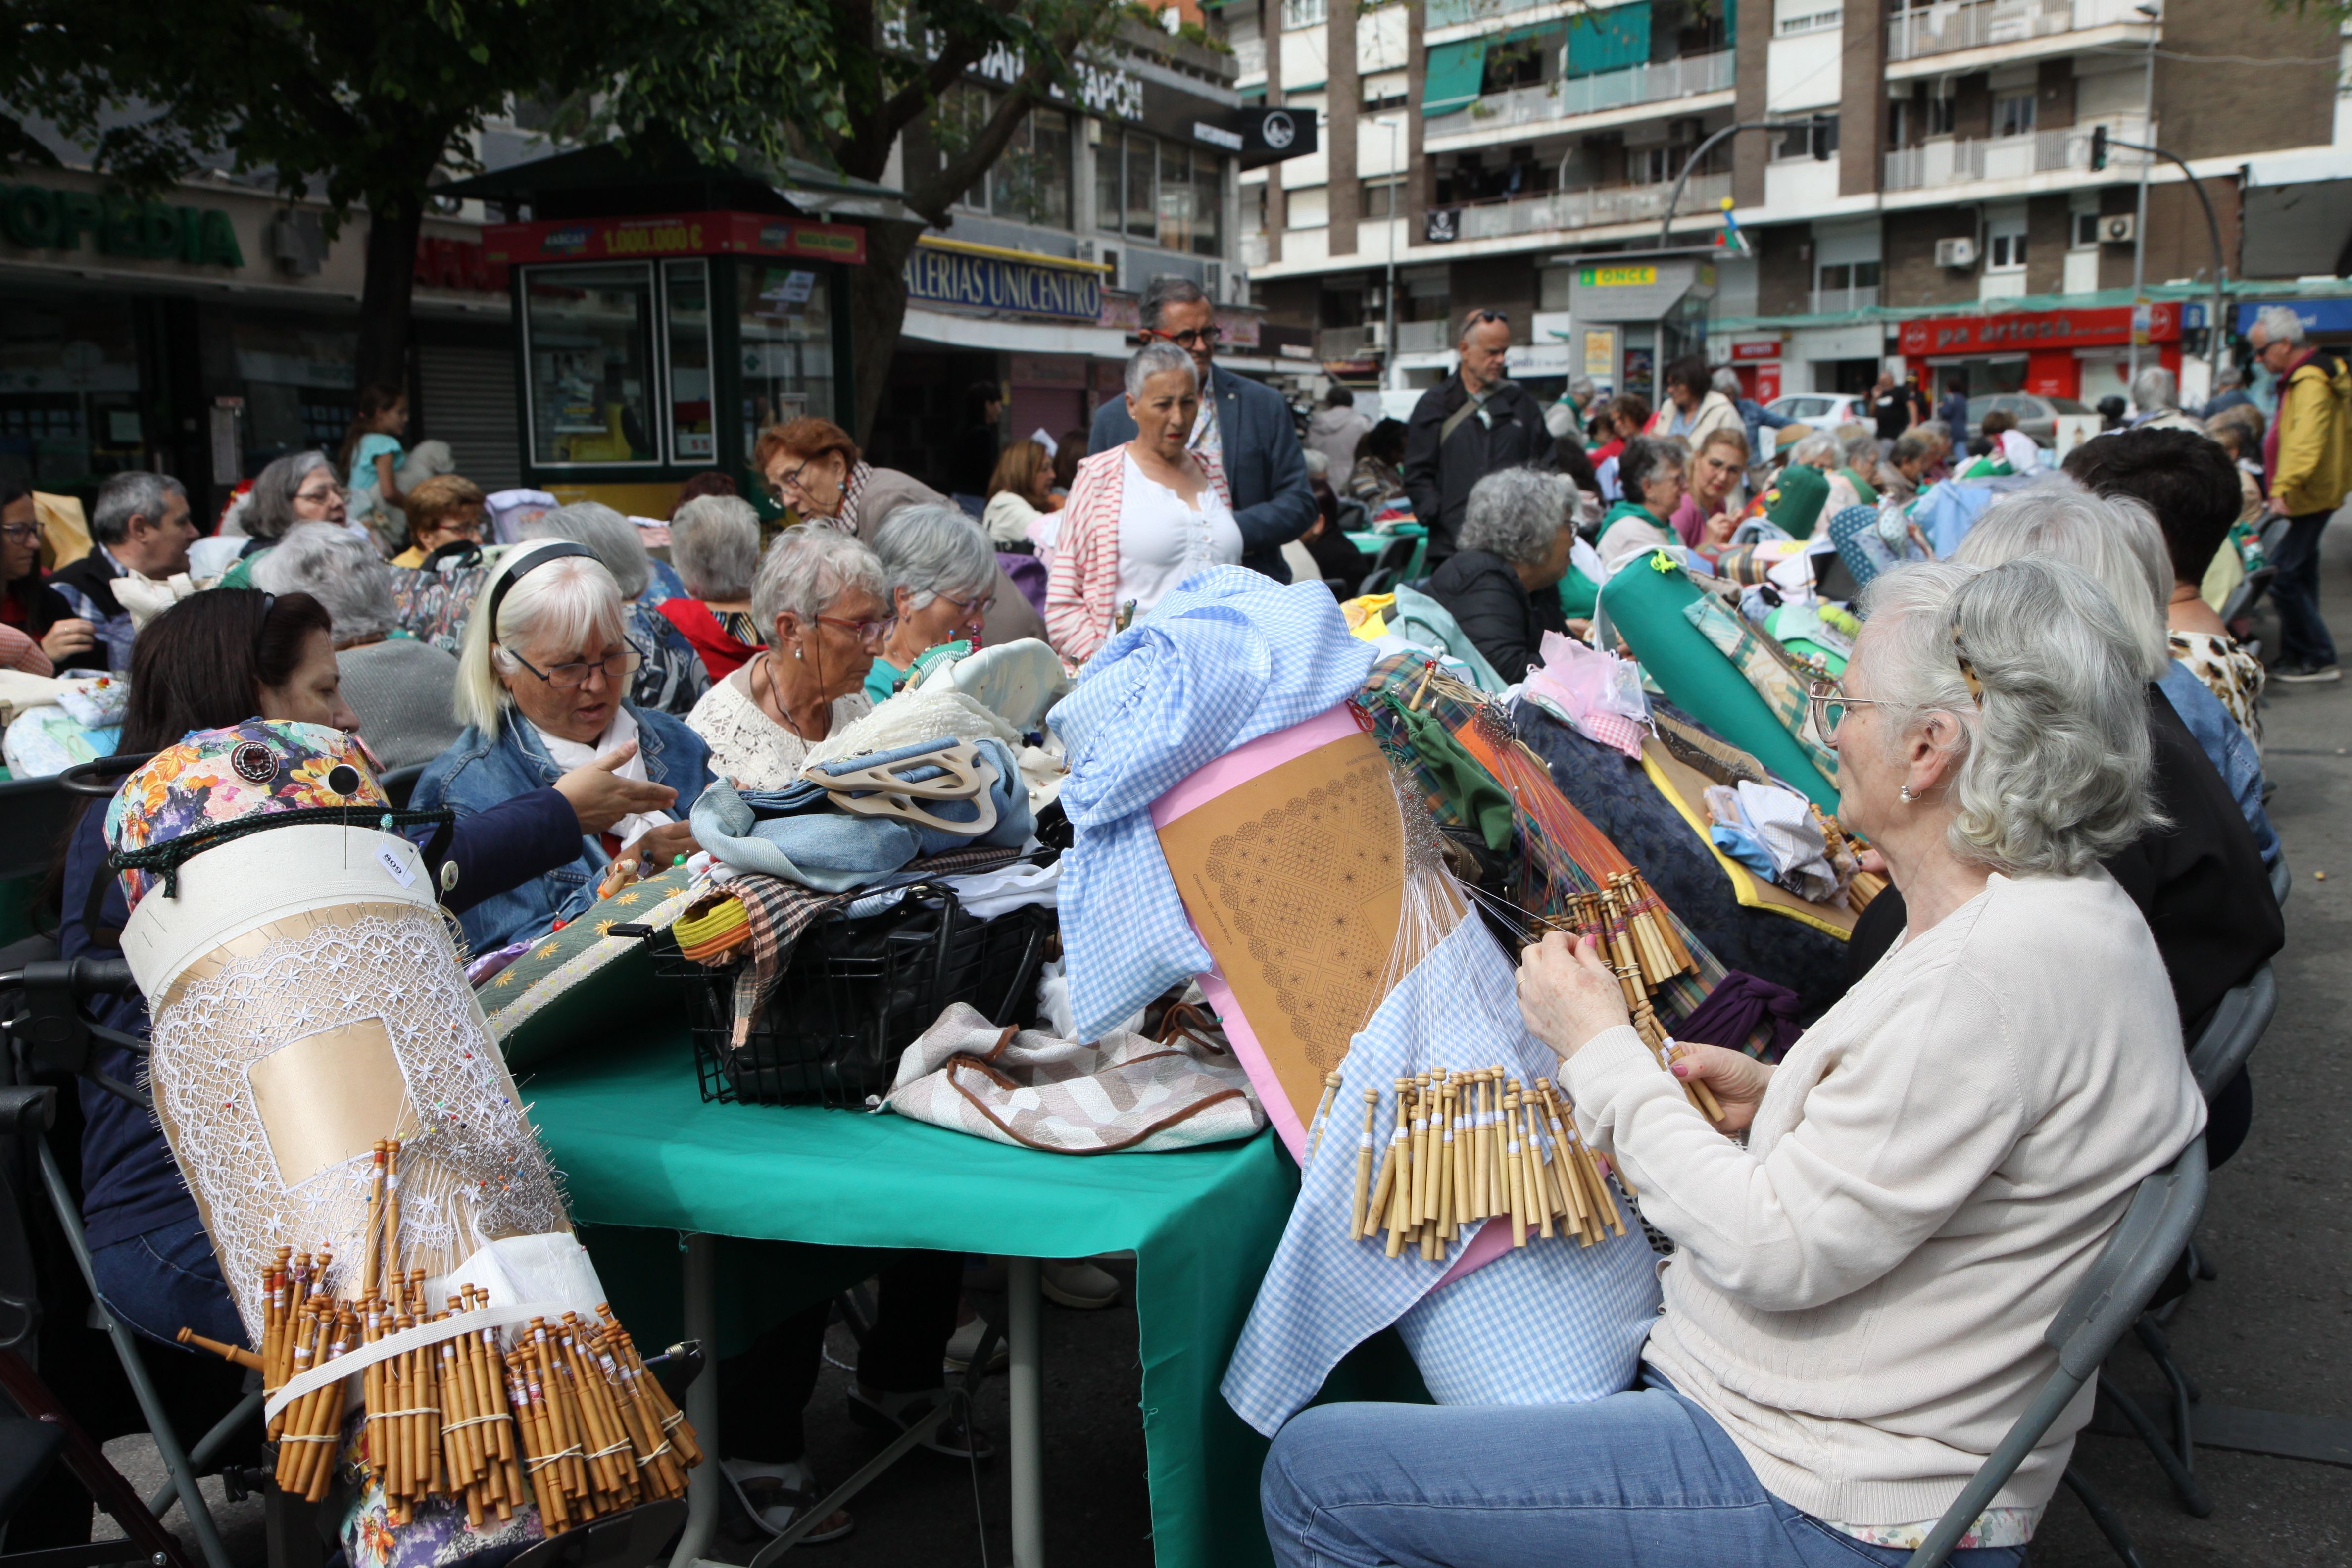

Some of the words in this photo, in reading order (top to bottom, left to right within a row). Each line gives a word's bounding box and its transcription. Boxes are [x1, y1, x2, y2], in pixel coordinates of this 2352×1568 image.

[0, 181, 244, 267] OPEDIA
[902, 250, 984, 305] ALERIAS
[989, 261, 1100, 317] UNICENTRO
[1601, 268, 1648, 282] ONCE
[1938, 326, 1969, 348] pa
[384, 853, 402, 874] 809
[1193, 873, 1209, 902] ORIGINAL
[1207, 901, 1215, 910] DE
[1212, 910, 1224, 928] JORDI
[1222, 928, 1234, 946] ROCA
